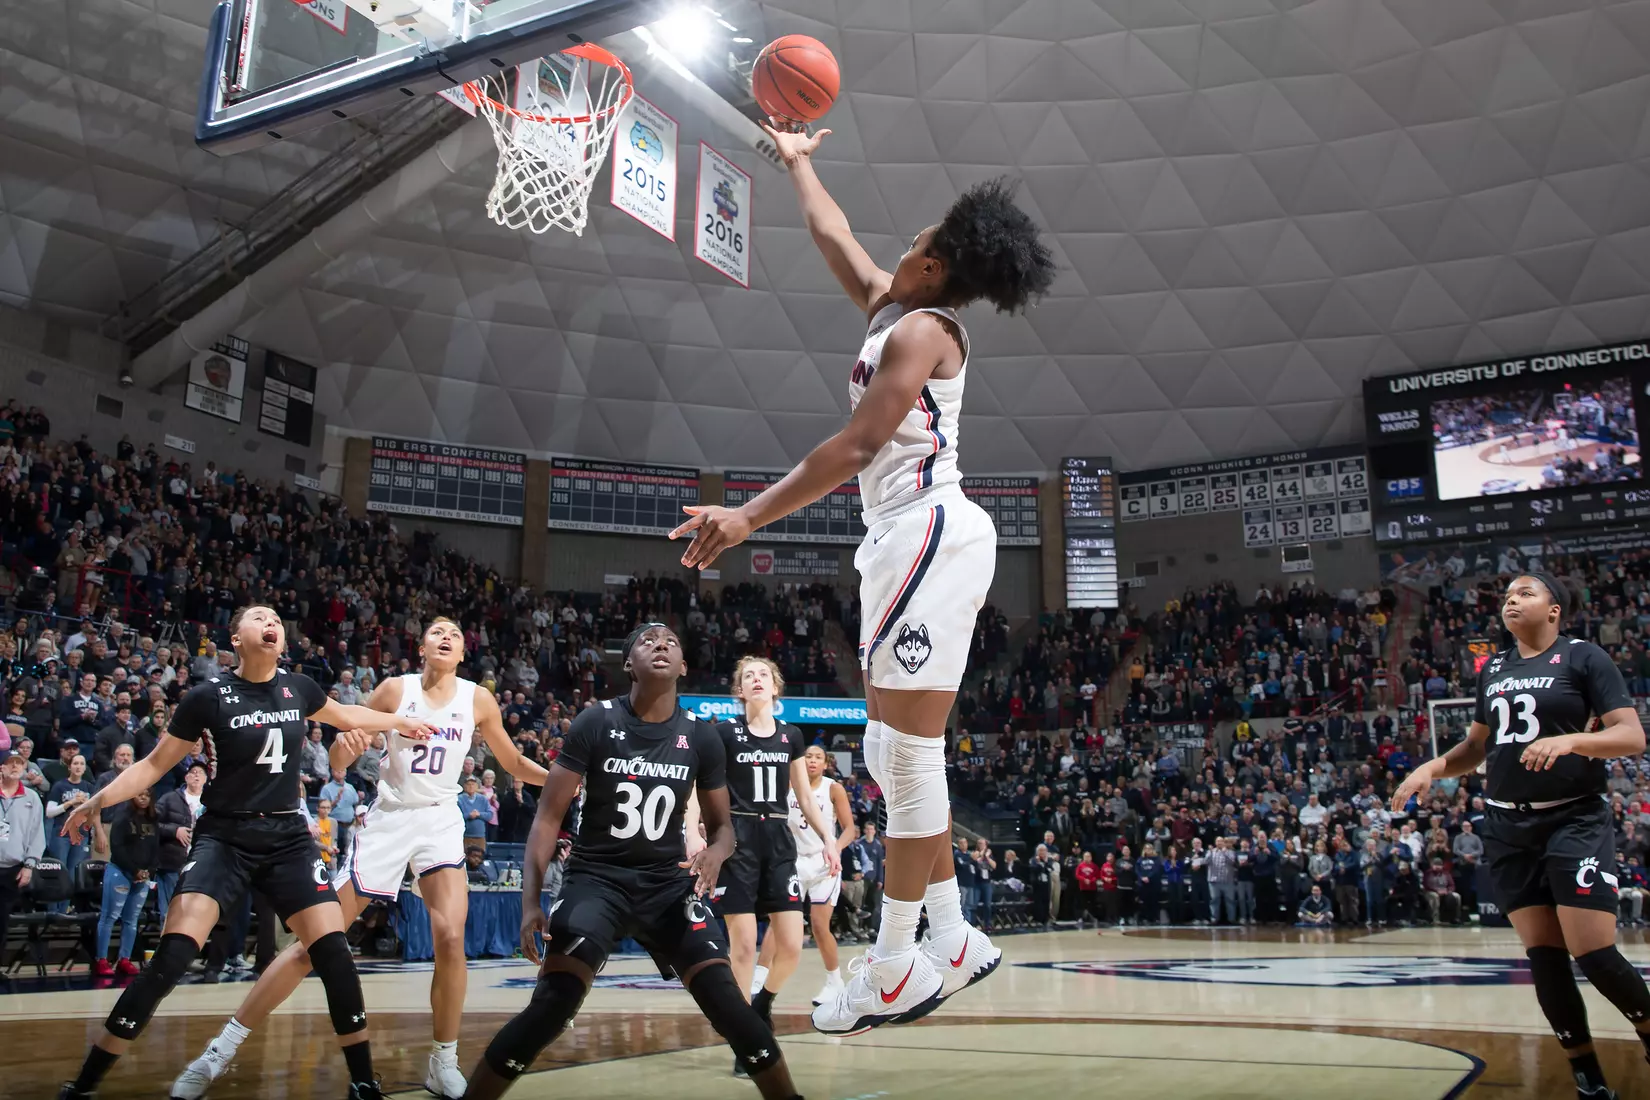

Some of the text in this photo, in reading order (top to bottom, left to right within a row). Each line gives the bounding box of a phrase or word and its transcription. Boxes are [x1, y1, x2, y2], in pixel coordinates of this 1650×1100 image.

[622, 158, 666, 202] 2015
[623, 184, 665, 217] NATIONAL
[619, 196, 668, 232] CHAMPIONS
[704, 212, 744, 254] 2016
[702, 248, 744, 281] CHAMPIONS
[705, 237, 741, 267] NATIONAL
[1389, 364, 1499, 393] UNIVERSITY
[1501, 360, 1527, 377] OF
[1378, 409, 1420, 422] WELLS
[1380, 419, 1421, 432] FARGO
[181, 440, 195, 451] 211
[375, 439, 524, 464] BIG EAST CONFERENCE
[467, 459, 524, 472] CHAMPIONS
[1170, 452, 1308, 476] UCONN HUSKIES OF HONOR
[565, 469, 687, 486] TOURNAMENT CHAMPIONS
[1387, 477, 1421, 492] CBS
[551, 492, 569, 503] 2016
[1127, 500, 1141, 514] C
[1159, 496, 1169, 511] 9
[1183, 492, 1206, 508] 22
[1213, 489, 1237, 505] 25
[1245, 485, 1269, 501] 42
[1276, 480, 1300, 497] 44
[1341, 473, 1366, 489] 42
[370, 503, 432, 515] CONNECTICUT
[464, 512, 520, 524] BASKETBALL
[551, 520, 610, 531] CONNECTICUT
[1247, 516, 1335, 541] 24 13 22
[219, 686, 232, 695] RJ
[1486, 676, 1556, 698] CINCINNATI
[230, 709, 300, 729] CINCINNATI
[1490, 693, 1541, 746] 23
[256, 728, 289, 774] 4
[410, 743, 448, 776] 20
[736, 749, 790, 763] CINCINNATI
[603, 756, 691, 781] CINCINNATI
[752, 766, 777, 802] 11
[609, 781, 677, 842] 30
[1576, 857, 1599, 888] C
